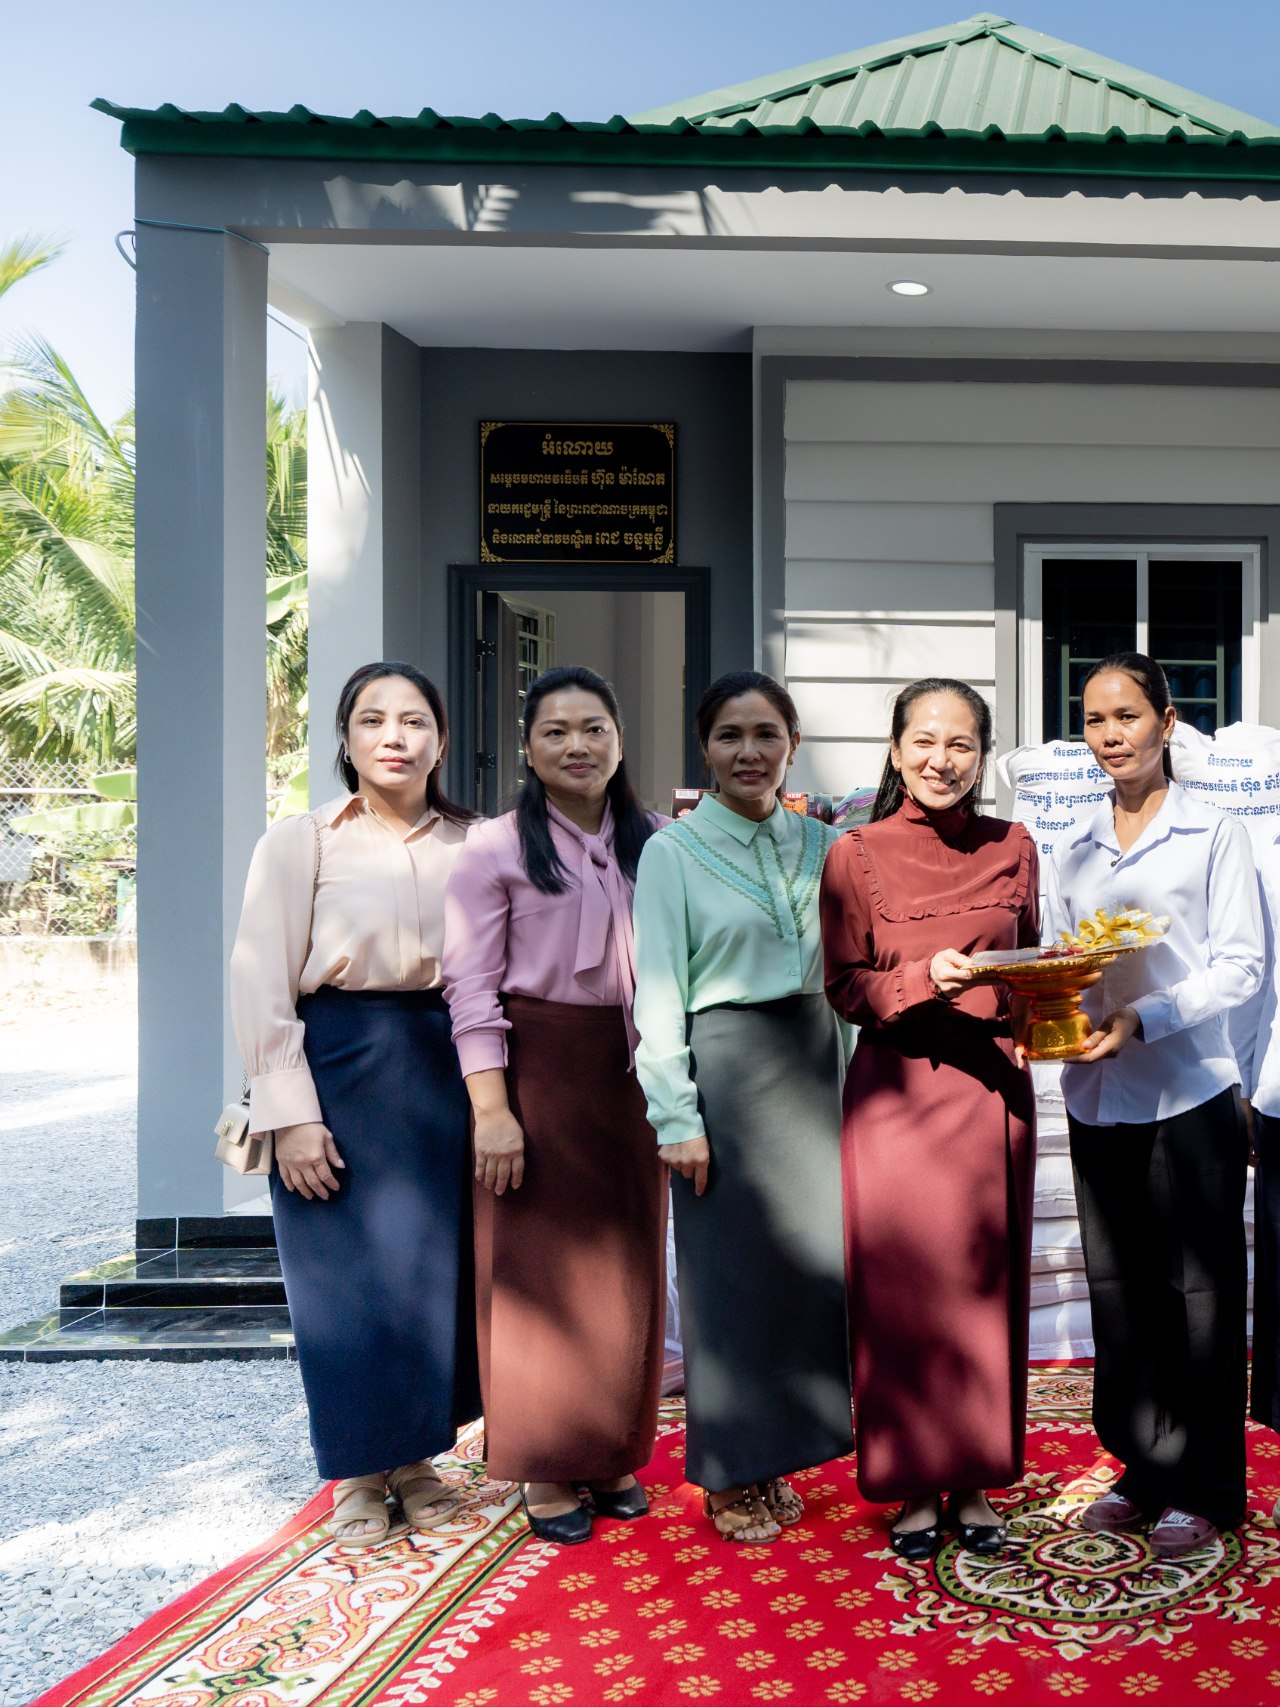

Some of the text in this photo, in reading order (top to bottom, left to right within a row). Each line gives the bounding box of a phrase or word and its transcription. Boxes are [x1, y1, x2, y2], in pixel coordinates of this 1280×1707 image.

[542, 433, 613, 456] អំណោយ
[595, 531, 620, 545] ពេជ
[1164, 1511, 1195, 1525] NIKE
